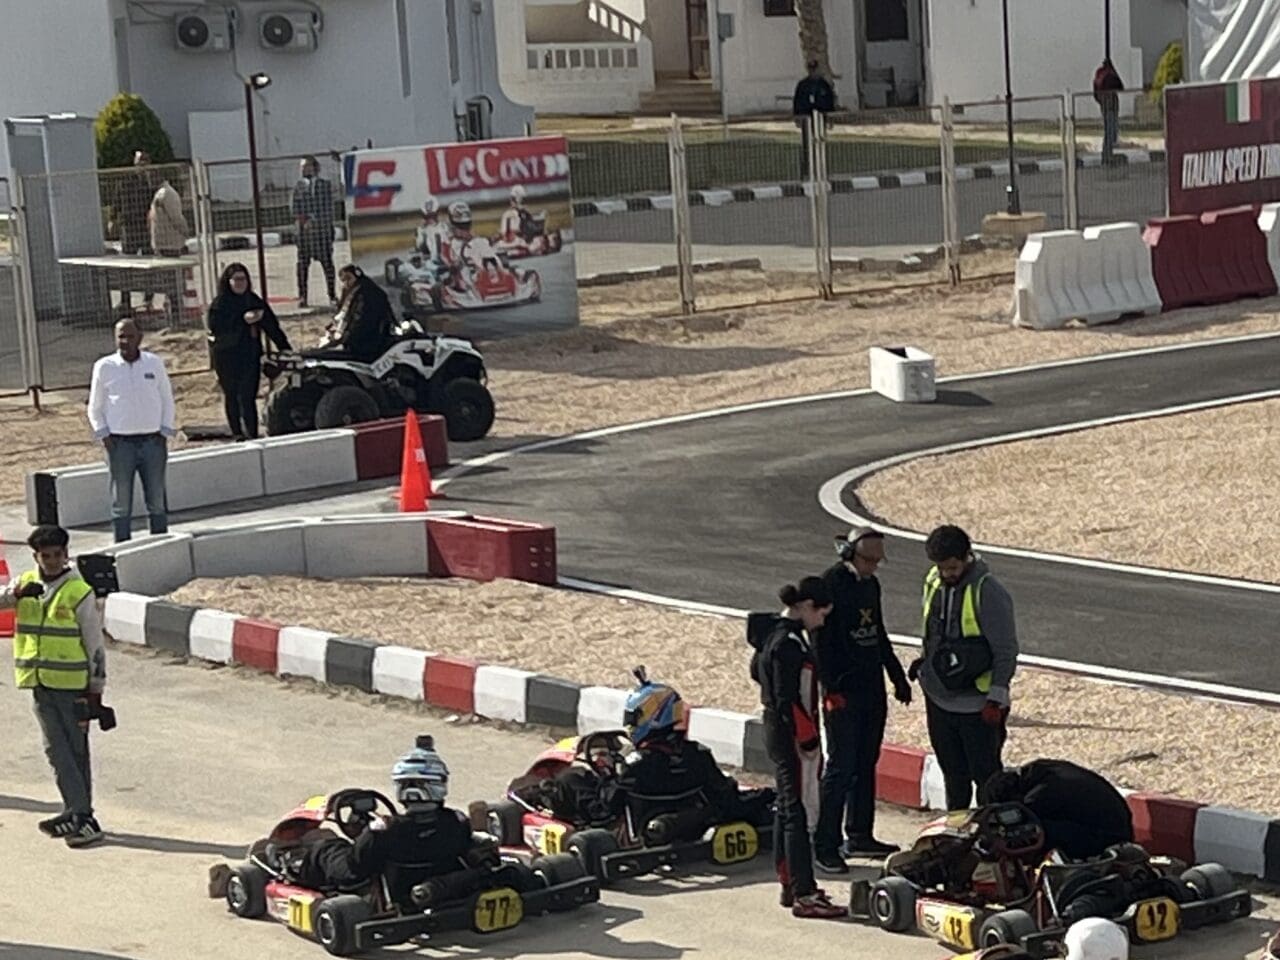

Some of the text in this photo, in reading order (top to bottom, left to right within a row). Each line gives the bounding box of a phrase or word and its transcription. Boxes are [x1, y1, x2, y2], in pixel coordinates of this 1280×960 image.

[1182, 150, 1224, 189] ITALIAN
[1225, 146, 1259, 184] SPEED
[724, 830, 747, 858] 66
[485, 896, 510, 927] 77
[1147, 902, 1167, 932] 12
[949, 916, 965, 946] 12
